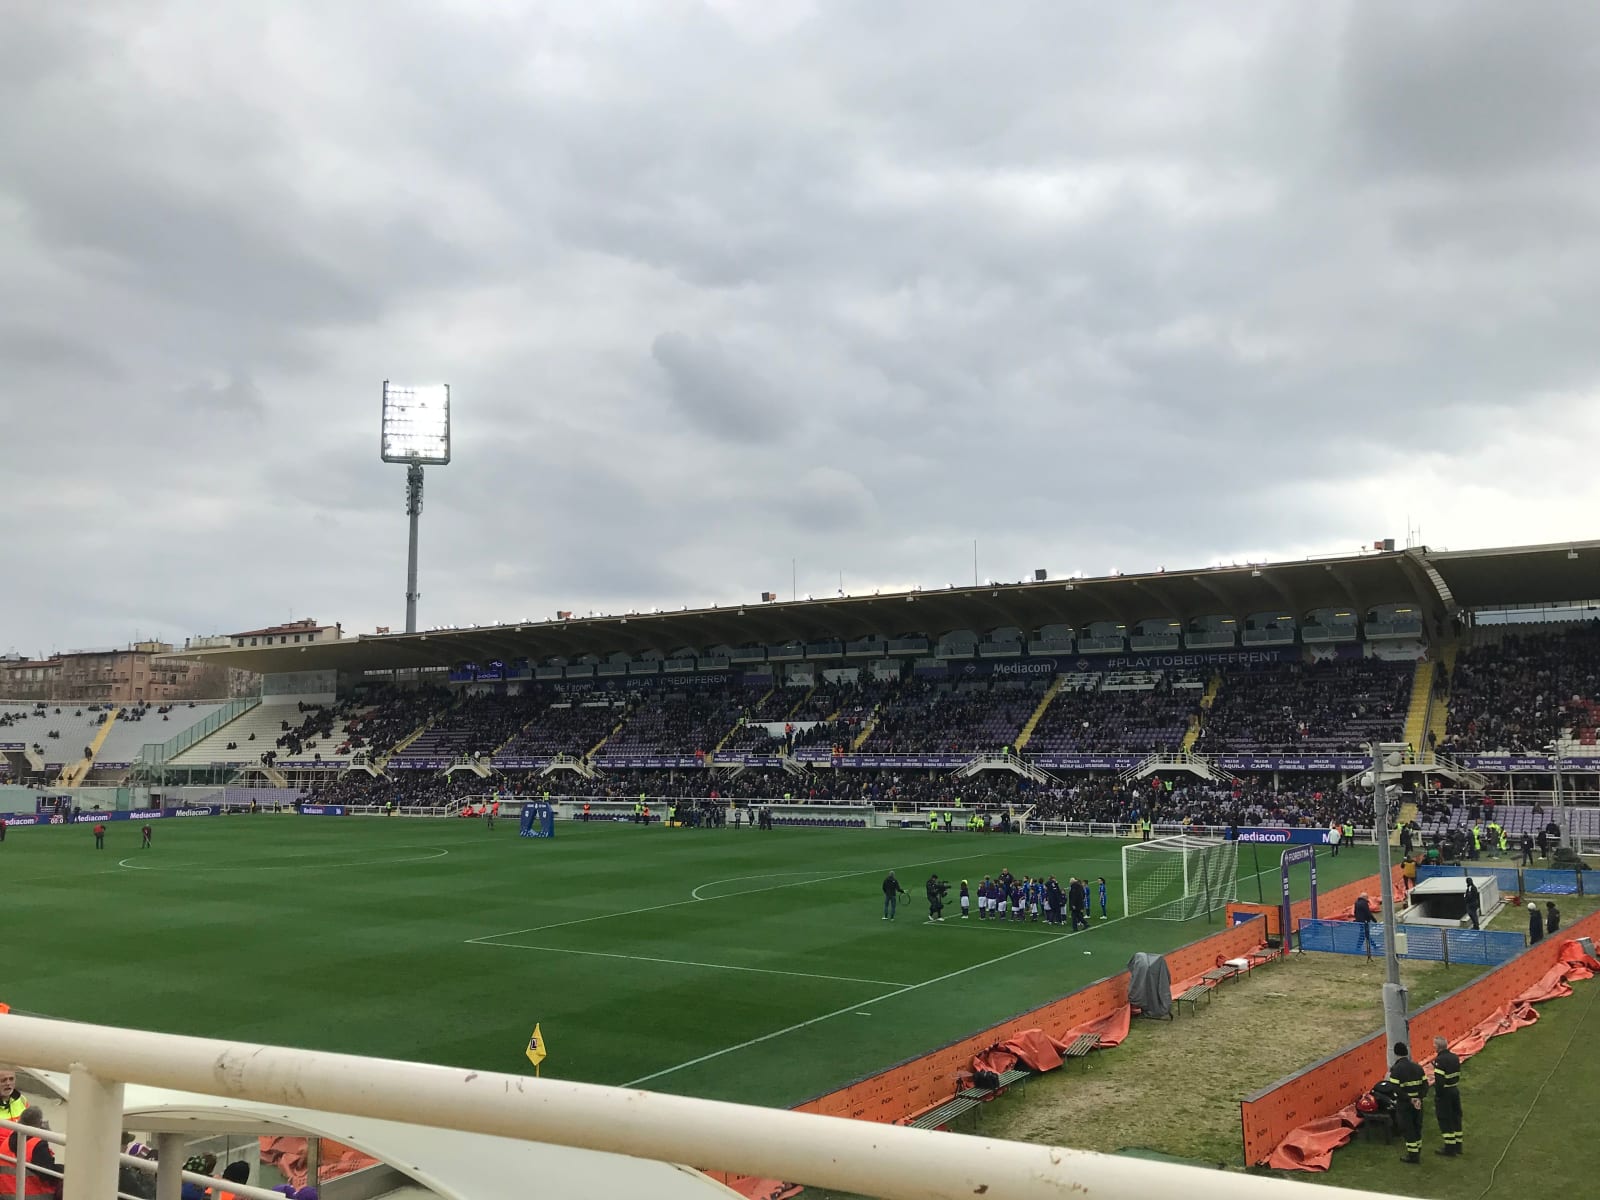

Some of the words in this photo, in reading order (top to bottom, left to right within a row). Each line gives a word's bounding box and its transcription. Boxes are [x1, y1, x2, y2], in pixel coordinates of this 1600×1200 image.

[993, 662, 1051, 674] Mediacom
[130, 811, 161, 819] Mediacom
[175, 808, 210, 817] Mediacom
[4, 817, 34, 826] ediacom
